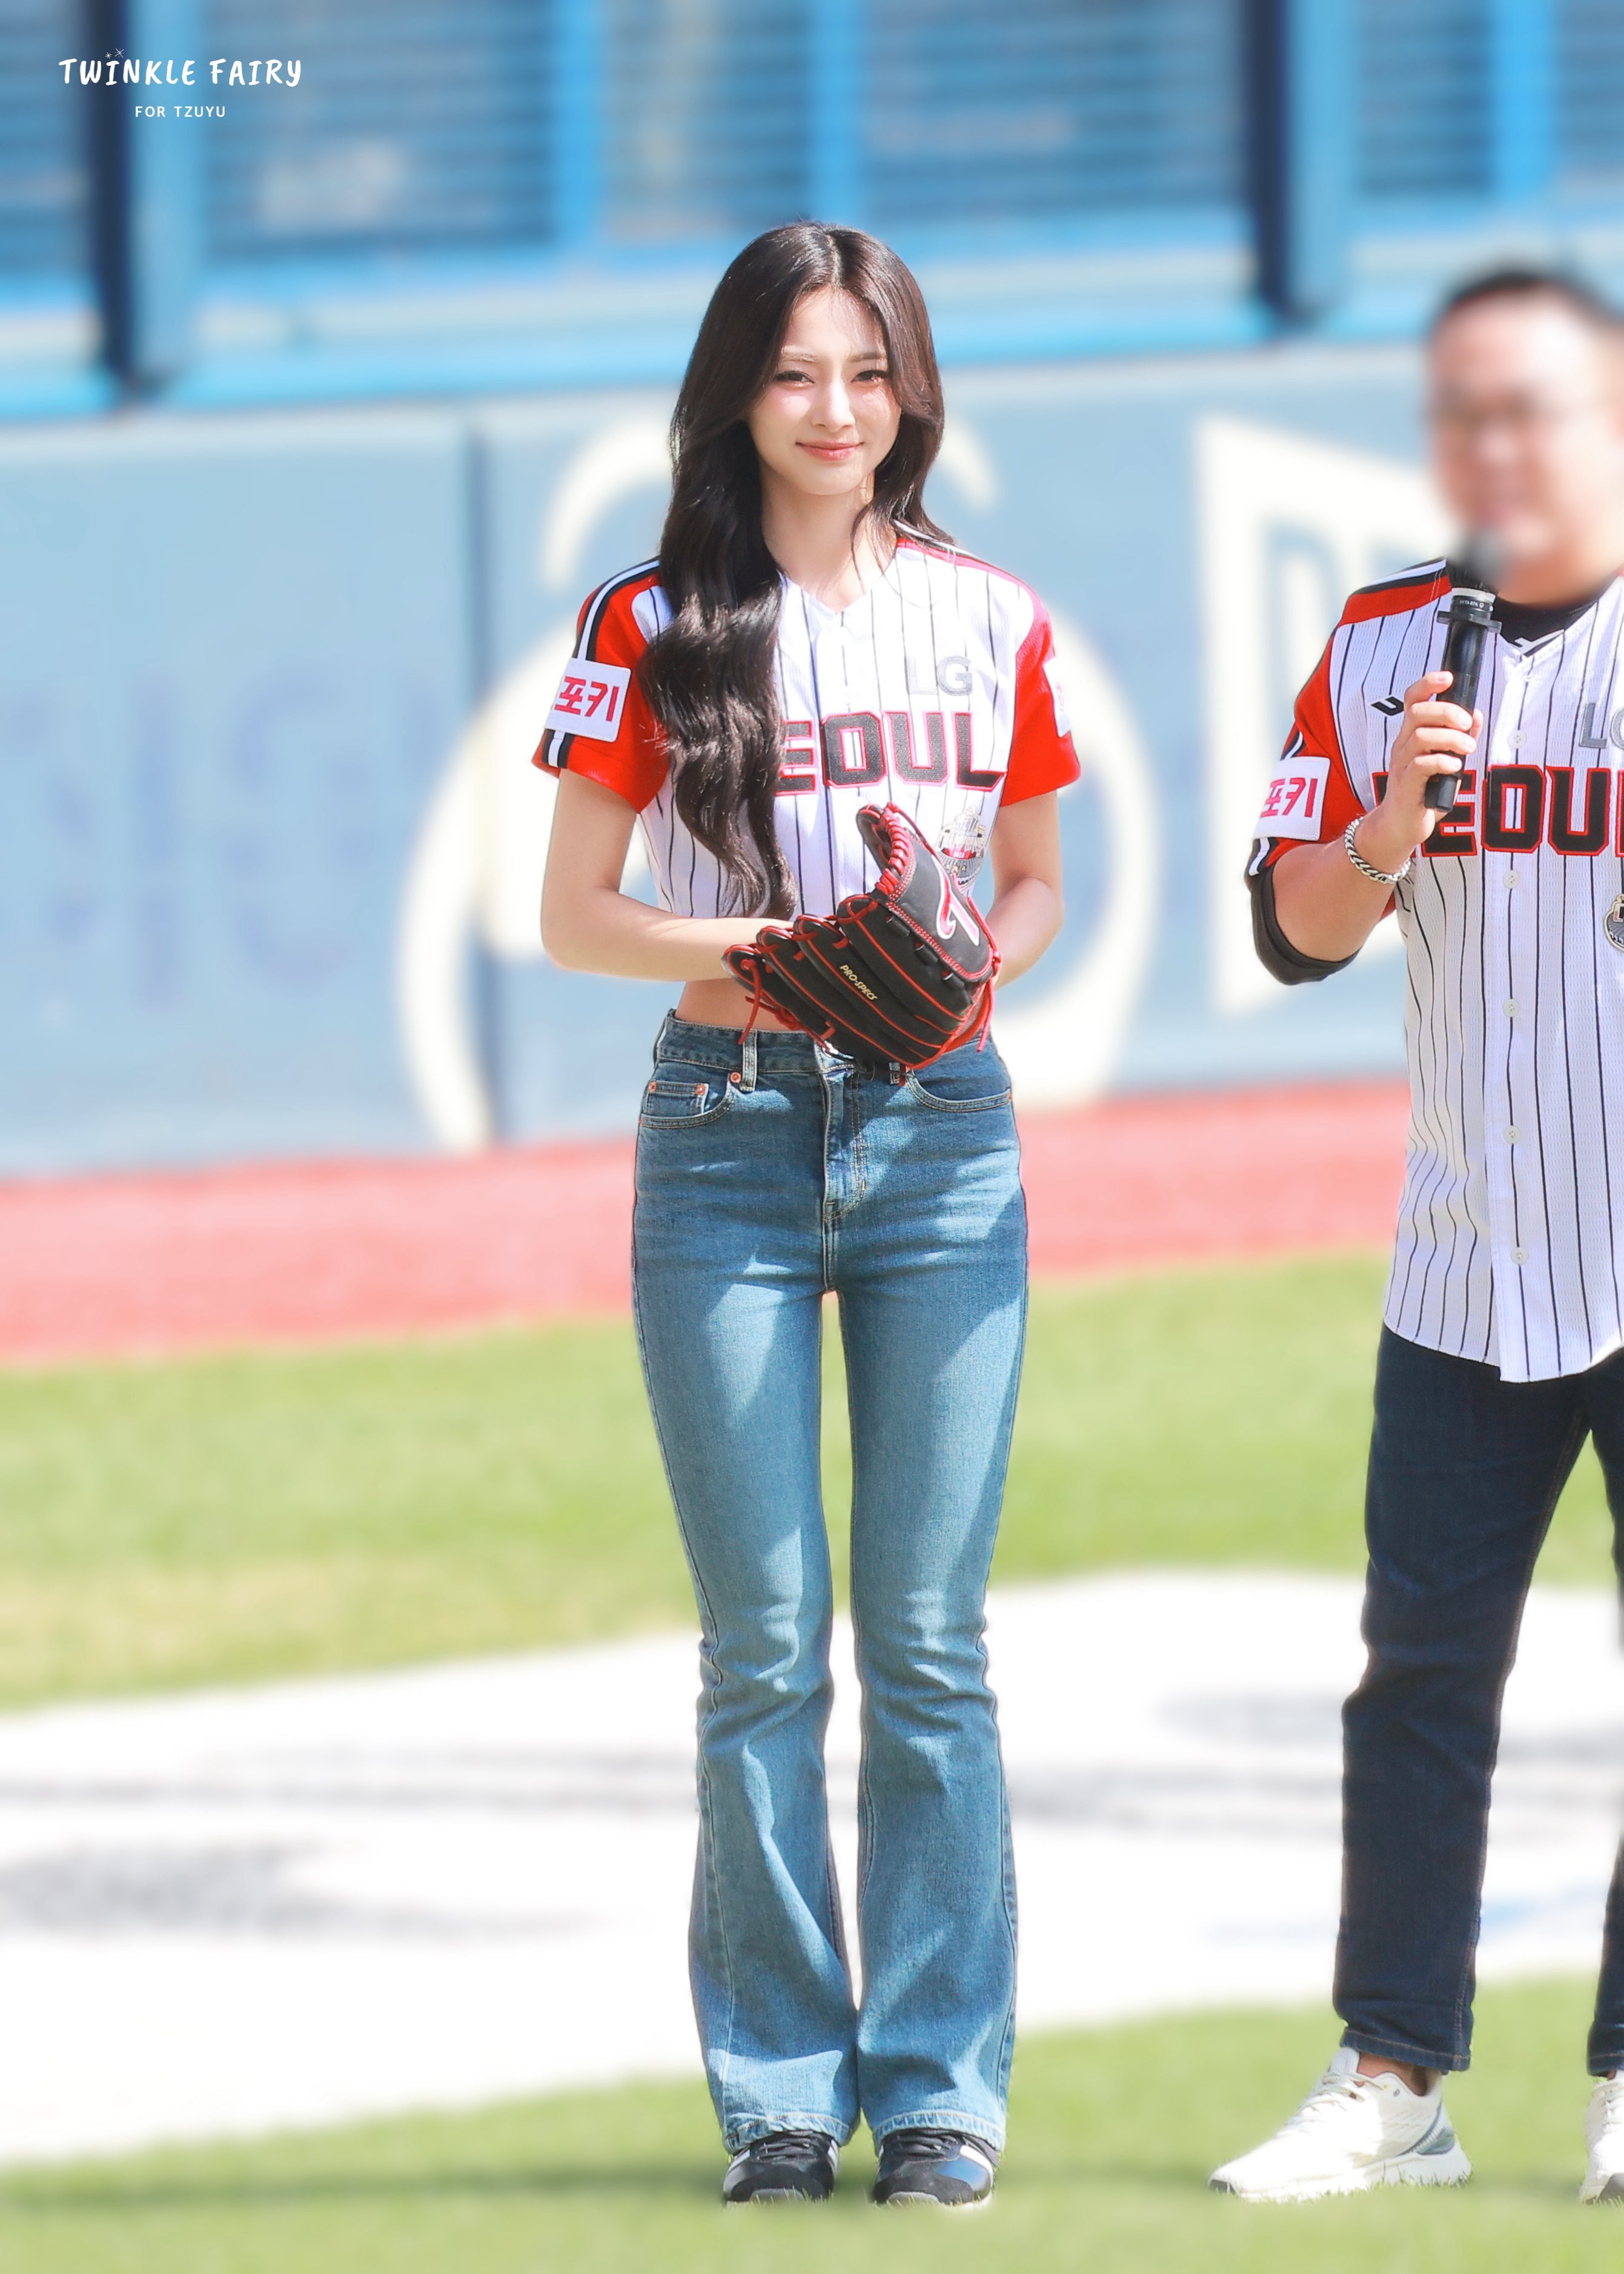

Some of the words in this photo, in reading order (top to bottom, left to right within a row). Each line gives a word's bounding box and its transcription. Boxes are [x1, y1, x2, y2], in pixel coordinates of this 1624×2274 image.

[908, 656, 973, 696] LG
[554, 676, 620, 722] 포키
[776, 710, 1007, 796] EOUL
[1260, 777, 1318, 819] 포키
[1371, 764, 1624, 857] EOU
[840, 965, 878, 1000] PRO-SPECS
